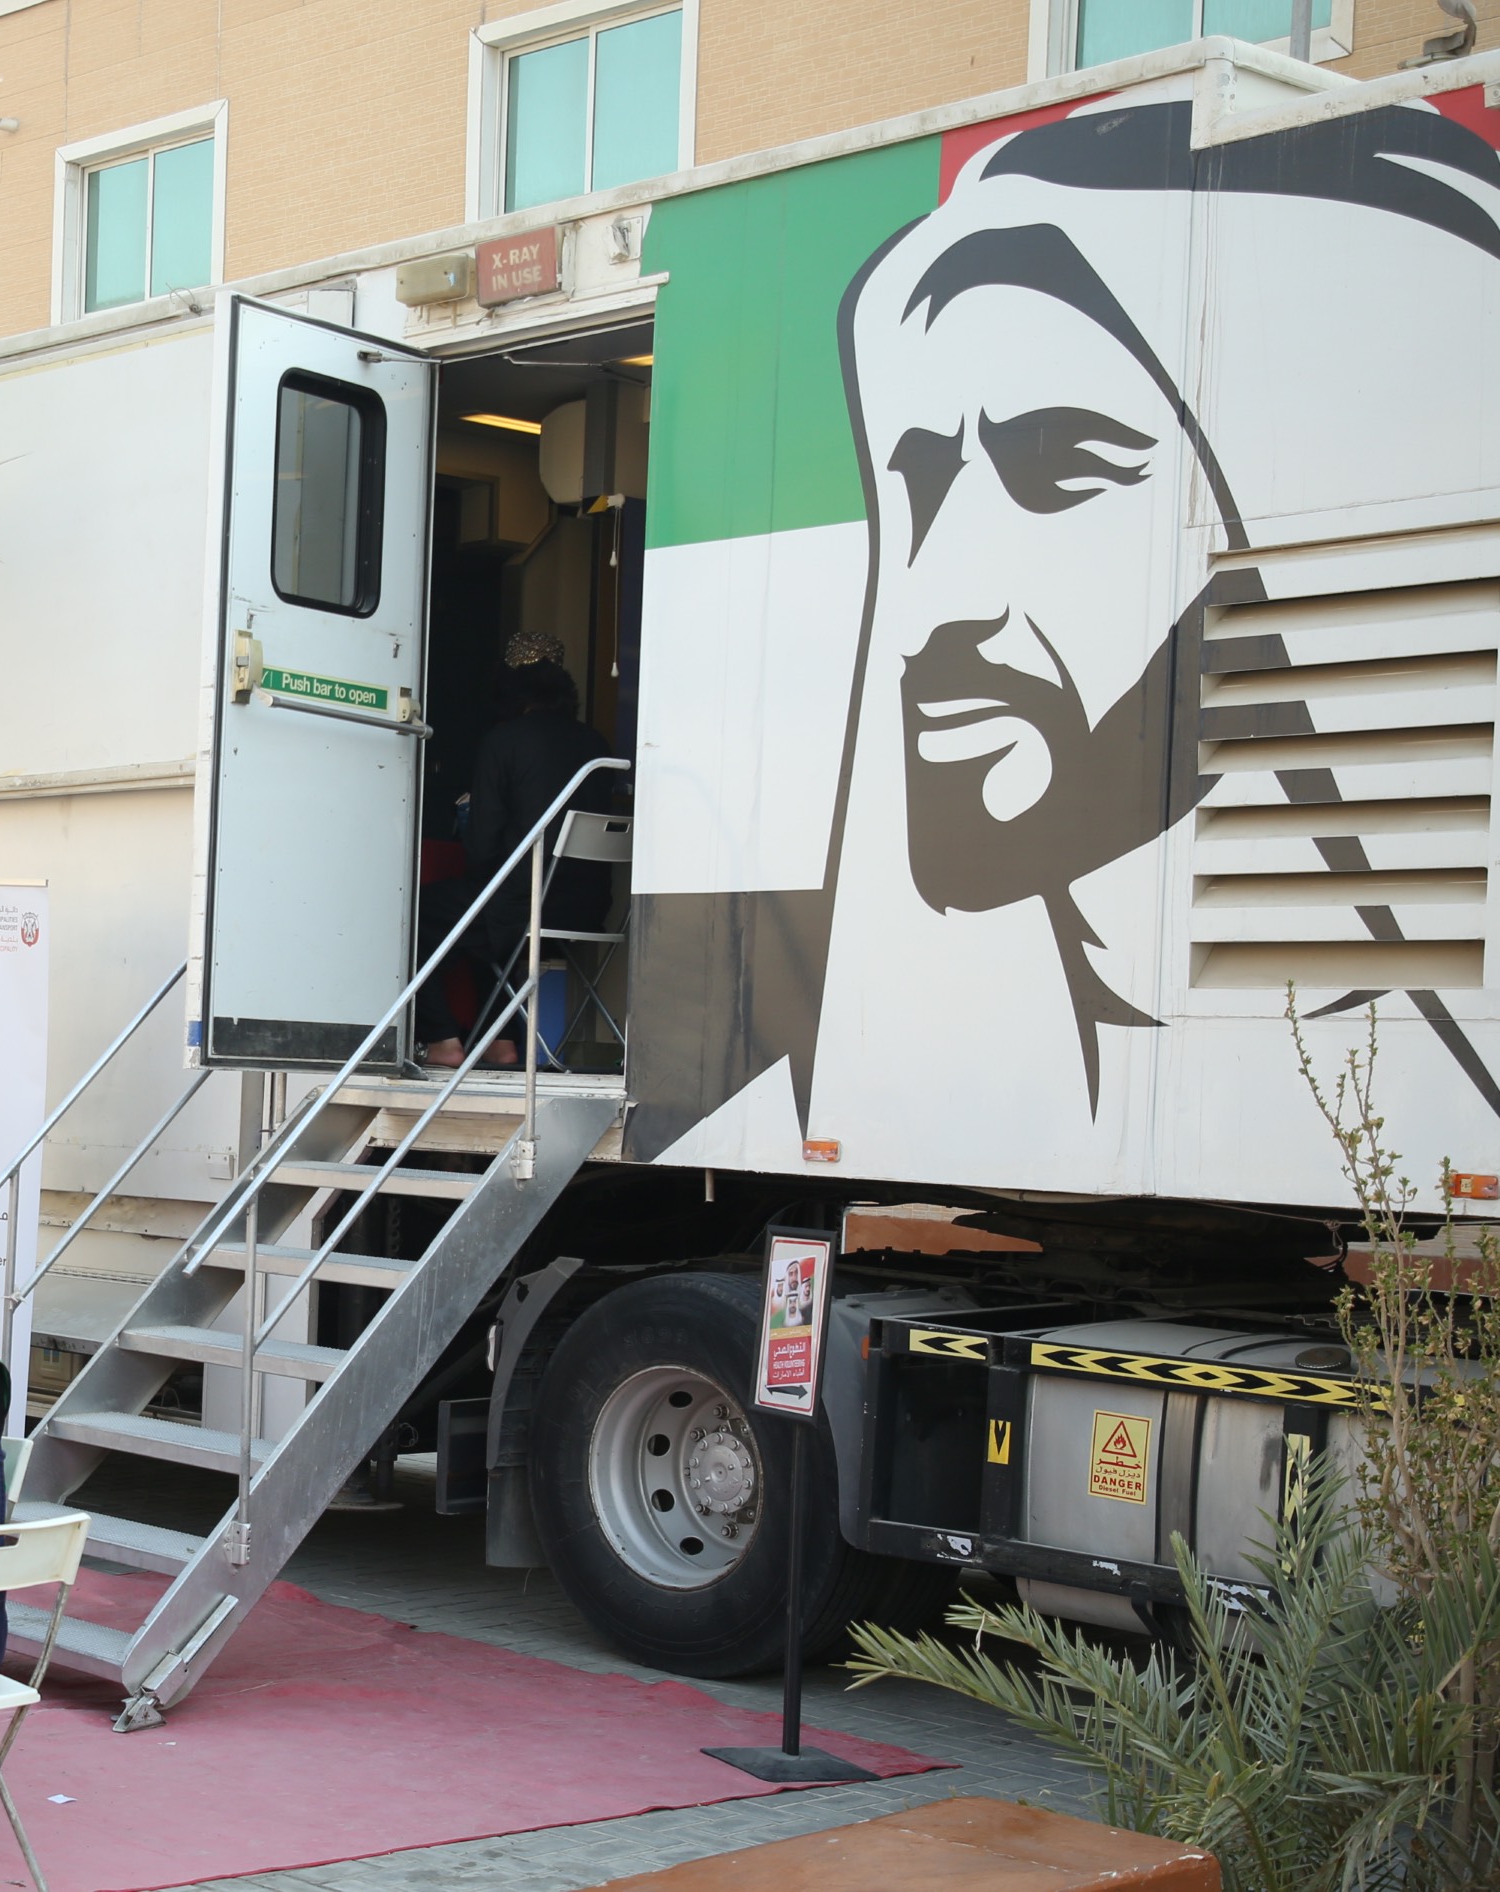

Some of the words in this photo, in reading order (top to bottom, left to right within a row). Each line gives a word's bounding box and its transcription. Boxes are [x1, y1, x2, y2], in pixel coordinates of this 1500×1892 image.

[491, 243, 541, 270] X-RAY
[492, 273, 508, 292] IN
[512, 266, 542, 287] USE
[282, 673, 311, 693] Push
[313, 679, 333, 697] bar
[334, 683, 347, 699] to
[349, 689, 377, 705] open
[1095, 1456, 1143, 1470] خطر
[1093, 1474, 1142, 1491] DANGER
[1098, 1484, 1119, 1494] Diesel
[1121, 1488, 1137, 1497] Fuel
